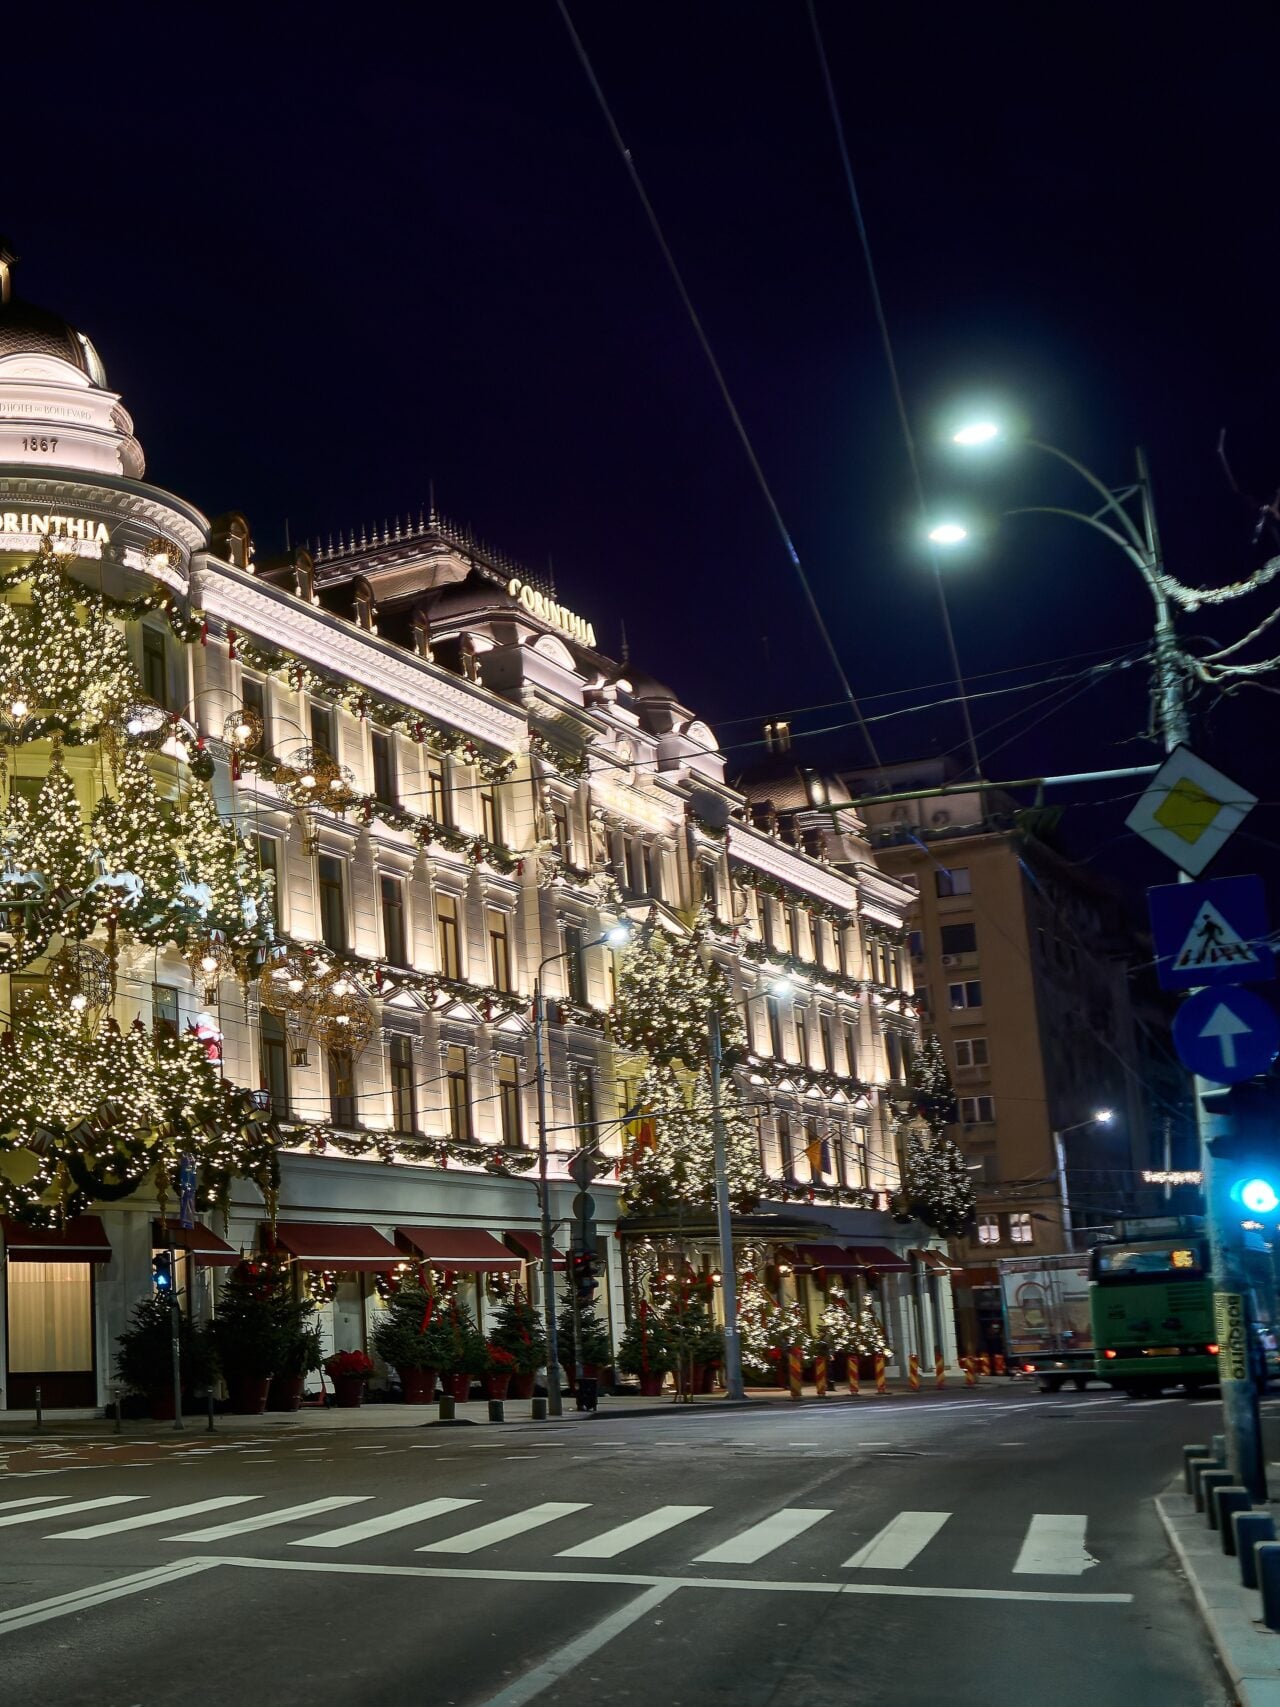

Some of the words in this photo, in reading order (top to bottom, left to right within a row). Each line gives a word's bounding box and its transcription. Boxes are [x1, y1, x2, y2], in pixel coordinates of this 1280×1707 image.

[7, 404, 33, 413] HOTEL
[44, 406, 92, 420] BOULEVARD
[22, 437, 58, 453] 1867
[508, 578, 597, 647] CORINTHIA
